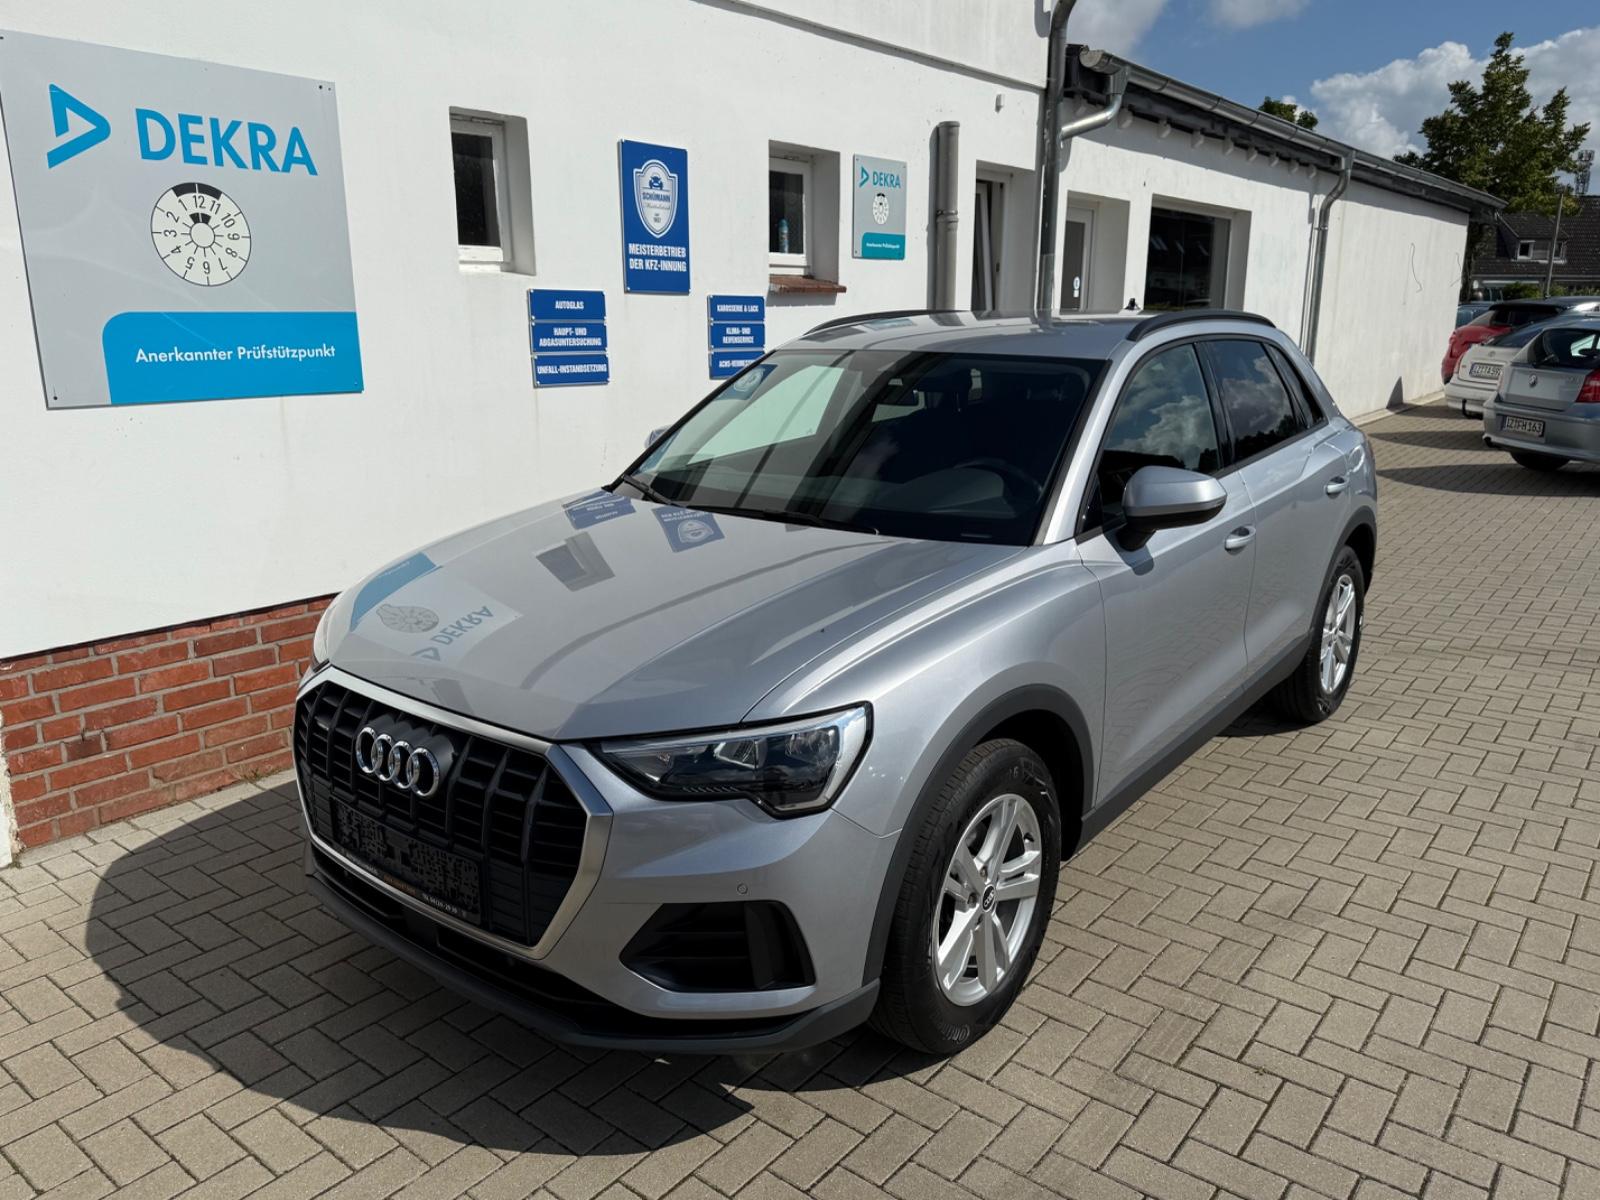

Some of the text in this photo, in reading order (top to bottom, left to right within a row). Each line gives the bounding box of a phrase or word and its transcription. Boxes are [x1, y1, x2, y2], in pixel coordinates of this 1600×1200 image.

[135, 108, 318, 176] DEKRA
[872, 171, 901, 188] DEKRA
[178, 199, 188, 211] 1
[192, 195, 206, 209] 12
[210, 200, 221, 215] 11
[166, 211, 180, 223] 2
[221, 212, 236, 228] 10
[163, 229, 178, 238] 3
[227, 233, 241, 241] 9
[170, 245, 182, 254] 4
[225, 247, 238, 258] 8
[628, 243, 687, 258] MEISTERBETRIEB
[185, 256, 195, 270] 5
[202, 261, 211, 275] 6
[218, 257, 228, 271] 7
[629, 258, 687, 272] DER KFZ-INNUNG
[555, 301, 585, 310] AUTOGLAS
[553, 327, 587, 336] HAUPT- UND
[539, 337, 602, 347] ABGASUNTERSUCHUNG
[135, 343, 336, 363] Anerkannter Prüfstützpunkt
[537, 363, 607, 375] UNFALL-INSTANDSETZUNG
